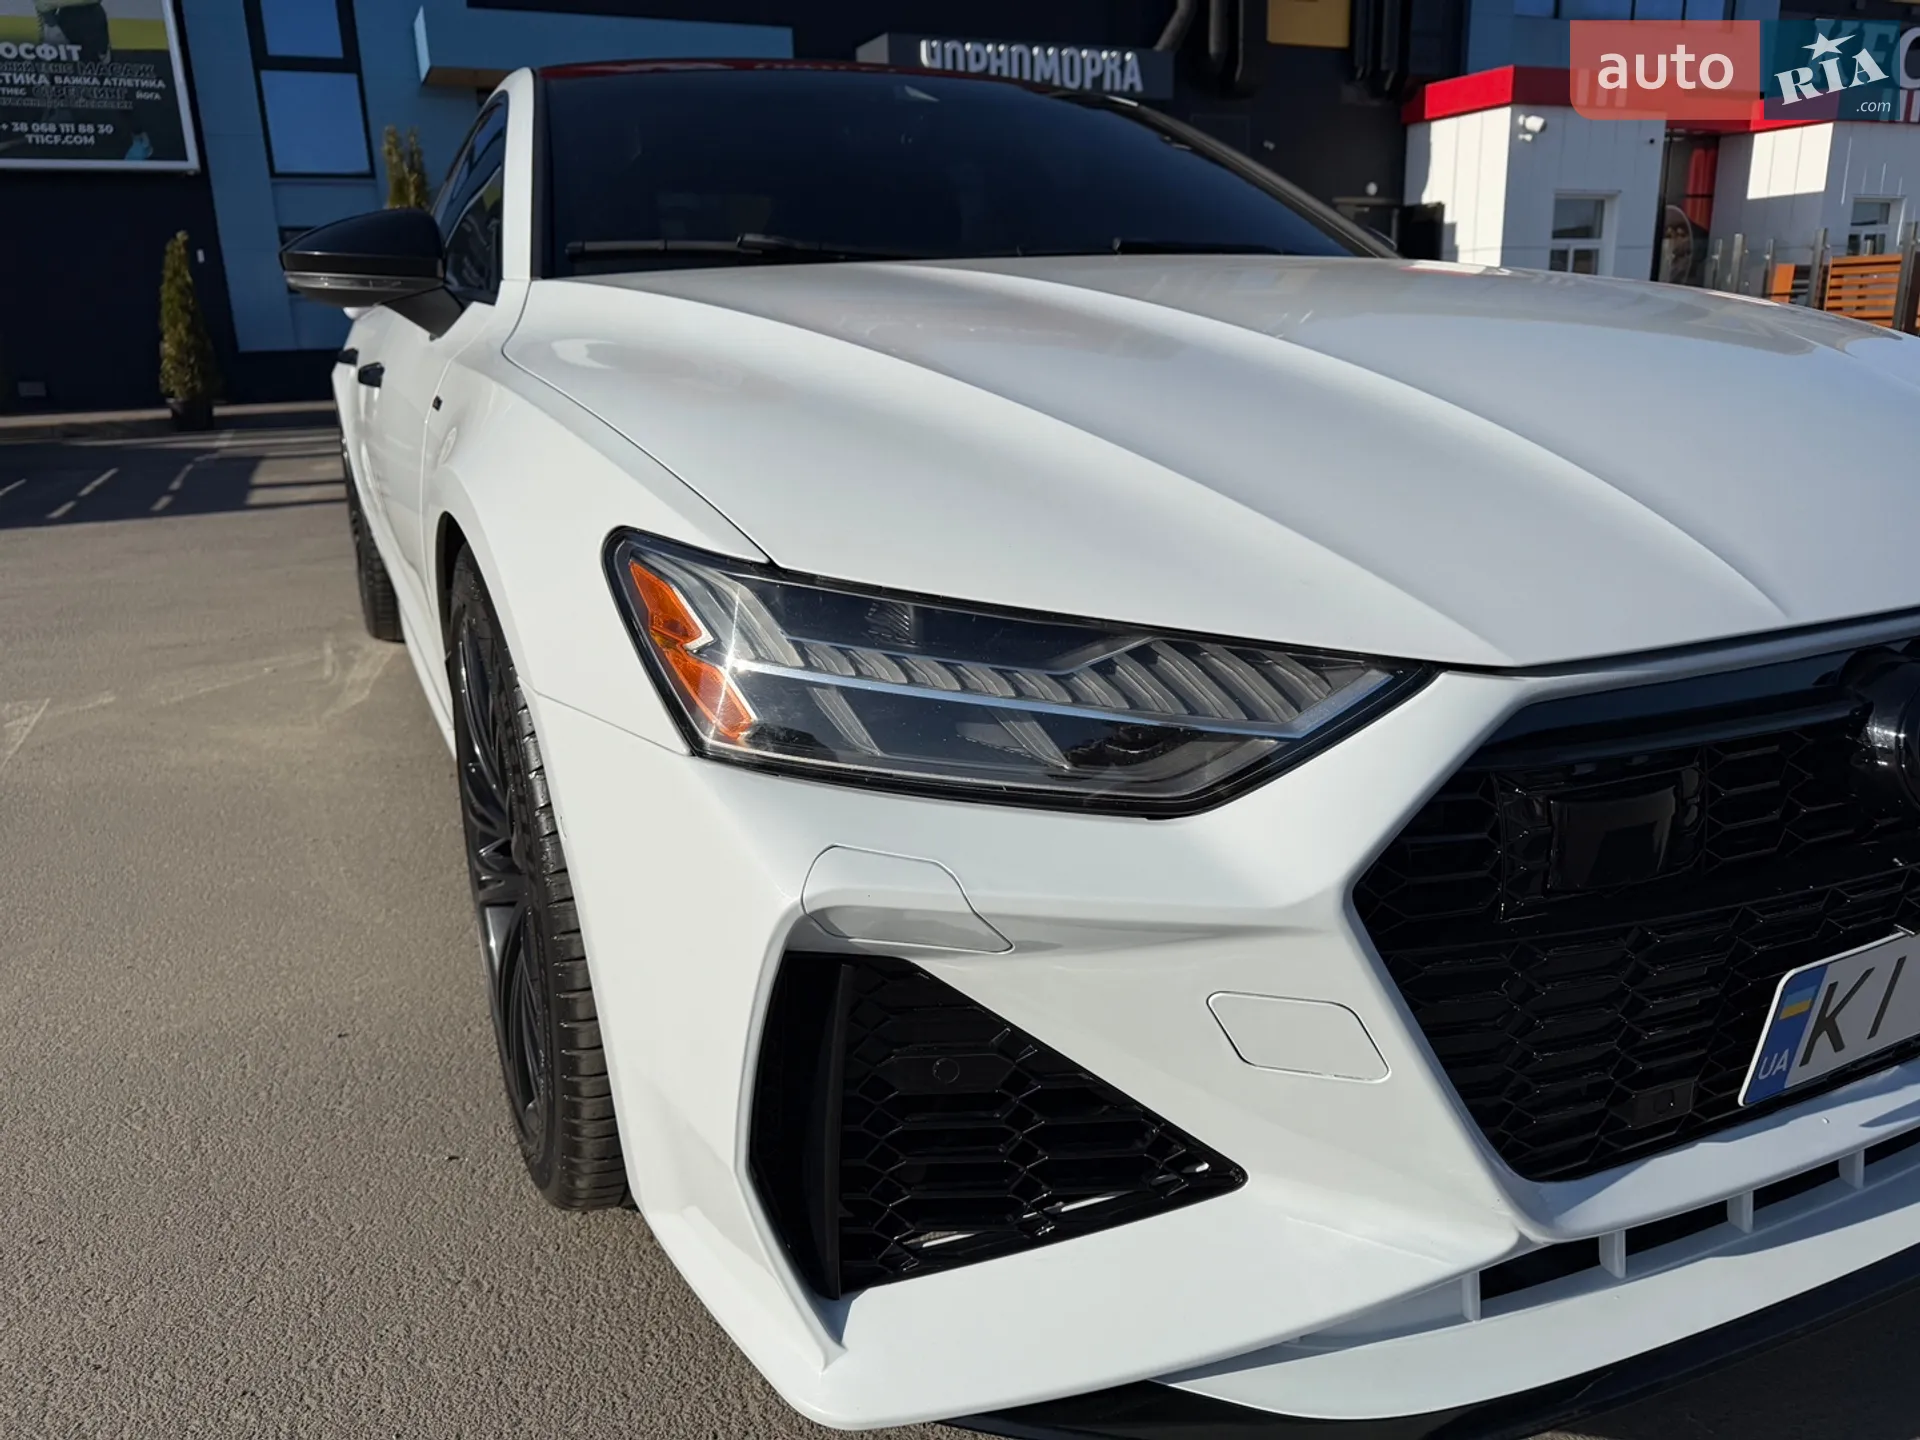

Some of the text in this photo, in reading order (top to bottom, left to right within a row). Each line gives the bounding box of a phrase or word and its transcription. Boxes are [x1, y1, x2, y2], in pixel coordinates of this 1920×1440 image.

[54, 75, 101, 87] ВАЖКА
[103, 77, 166, 89] АТЛЕТИКА
[136, 90, 162, 100] ЙОГА
[11, 121, 28, 133] 38
[1758, 1048, 1790, 1080] UA
